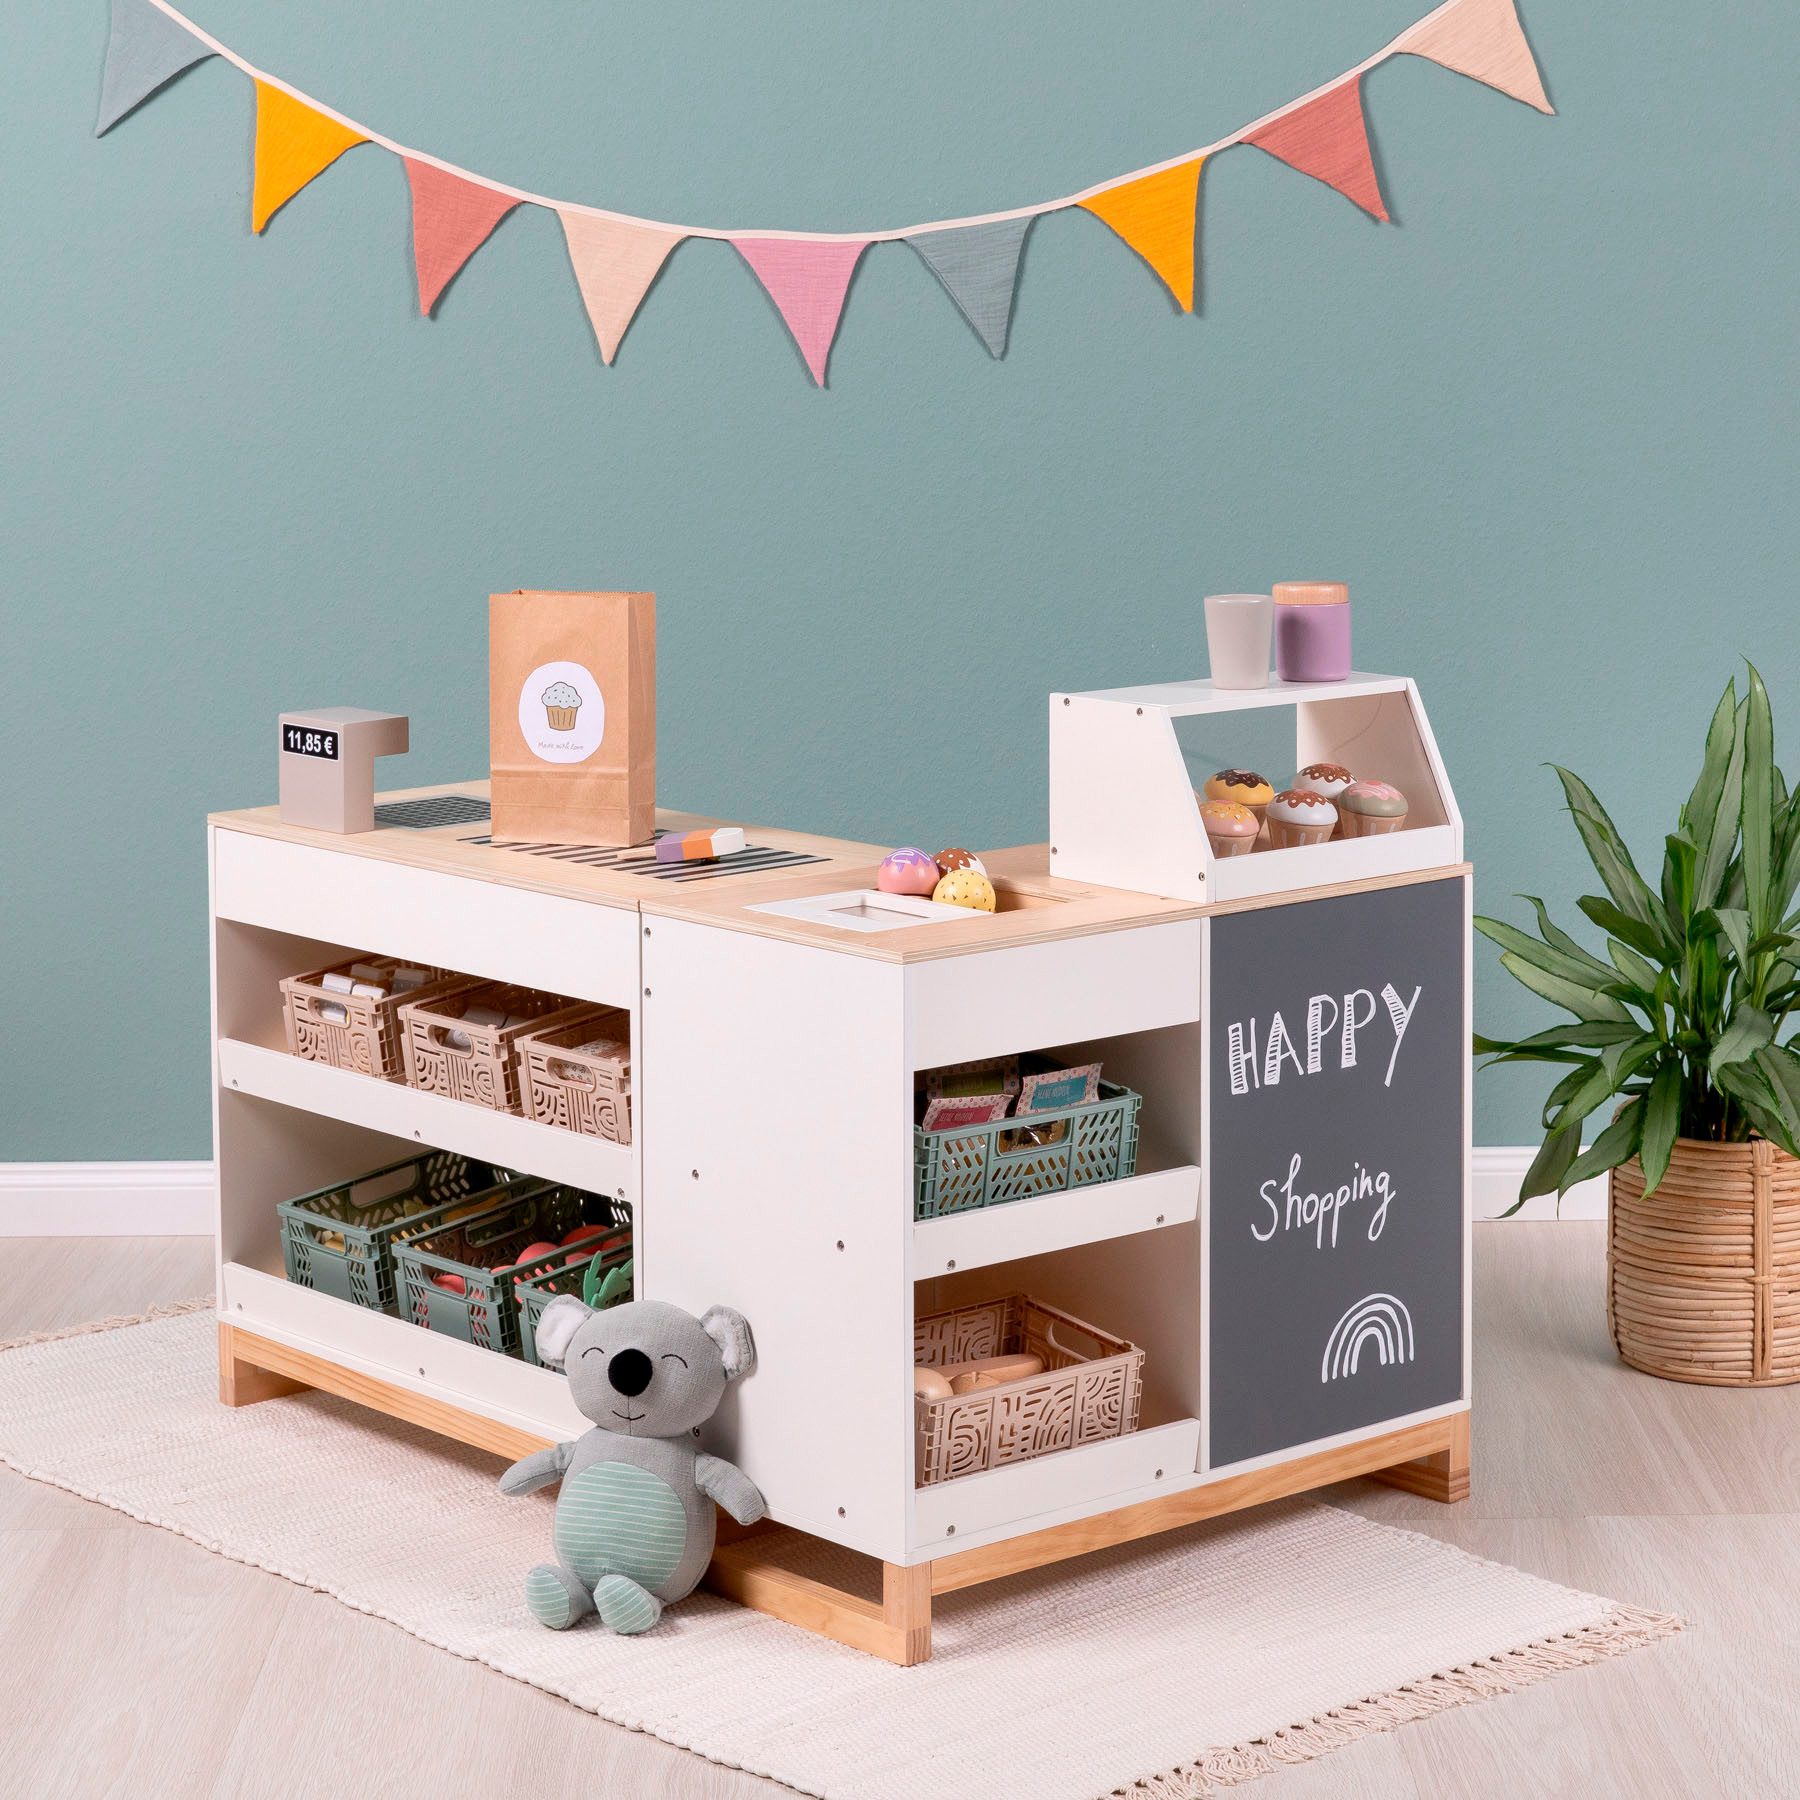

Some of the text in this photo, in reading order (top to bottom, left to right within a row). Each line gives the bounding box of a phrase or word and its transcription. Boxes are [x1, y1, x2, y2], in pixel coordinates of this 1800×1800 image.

[288, 730, 333, 755] 11,85 €
[1228, 983, 1421, 1095] HAPPY
